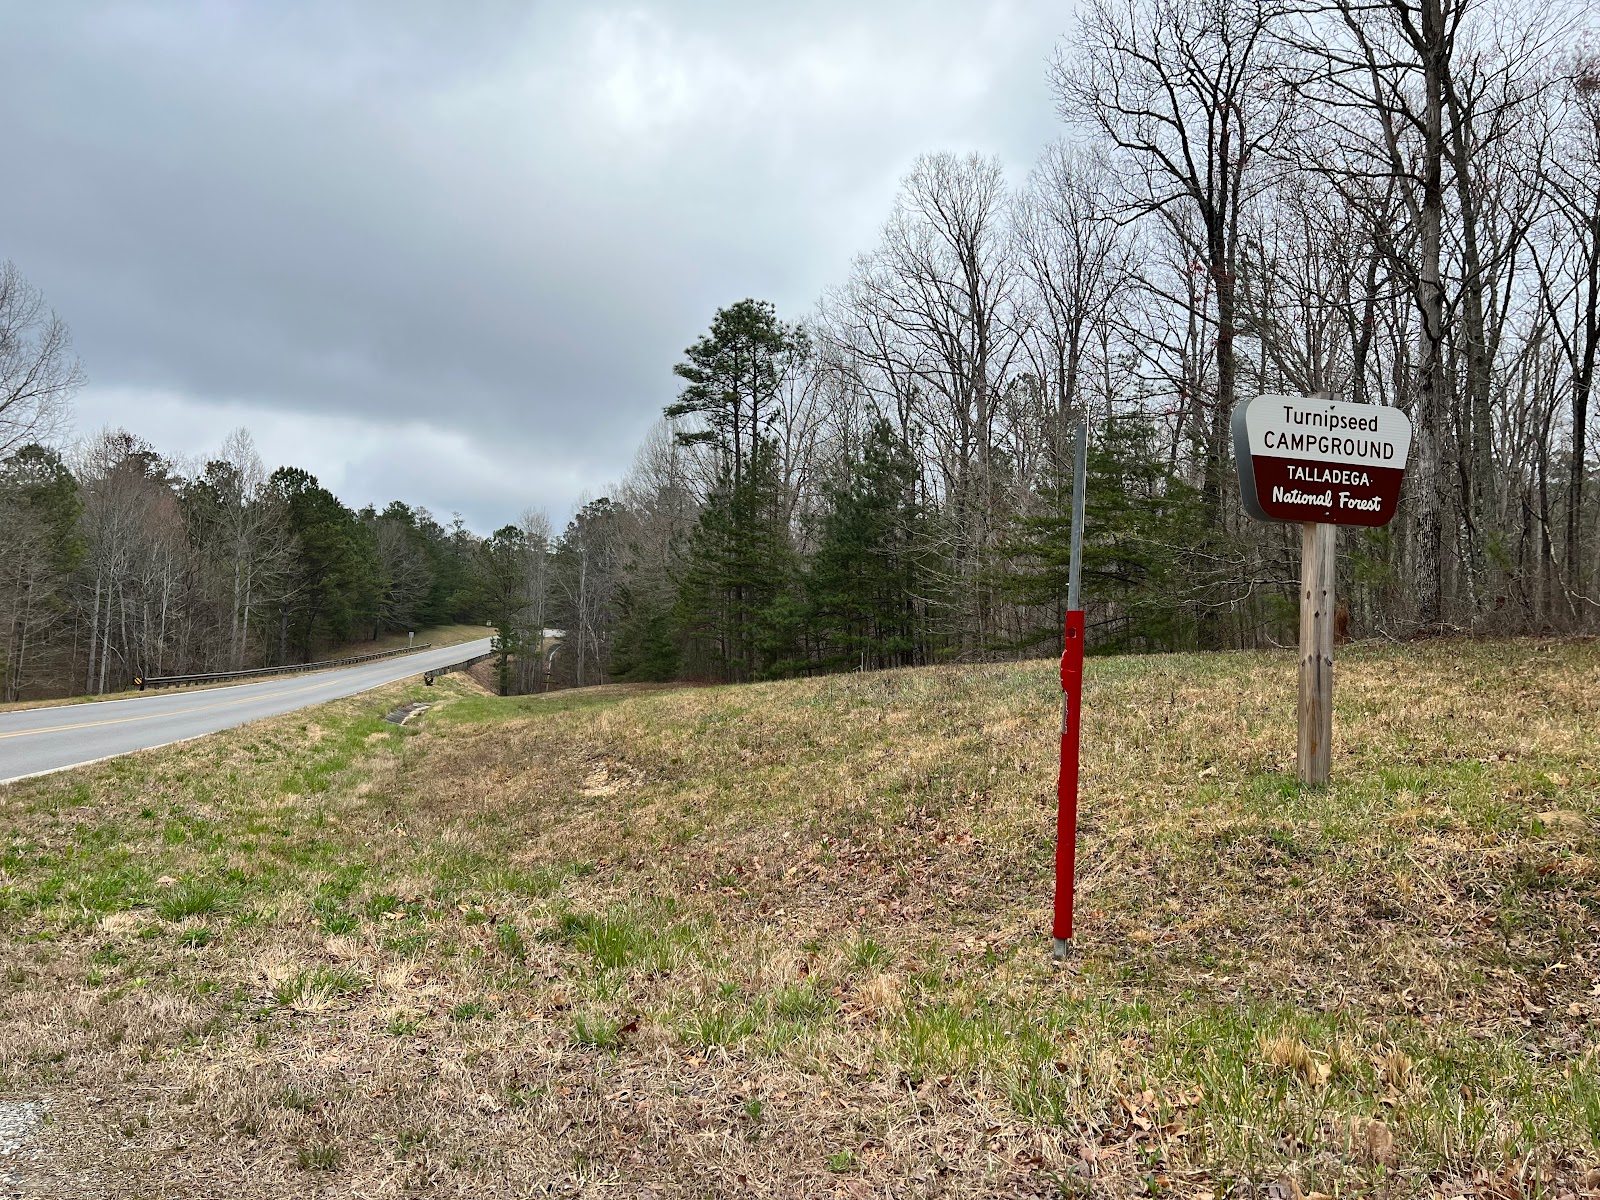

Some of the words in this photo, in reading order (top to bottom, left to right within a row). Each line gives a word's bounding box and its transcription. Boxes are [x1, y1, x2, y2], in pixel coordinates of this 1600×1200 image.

[1283, 405, 1378, 432] Turnipseed
[1264, 430, 1394, 460] CAMPGROUND
[1287, 465, 1370, 486] TALLADEGA
[1272, 486, 1333, 507] National
[1338, 491, 1382, 511] Forest
